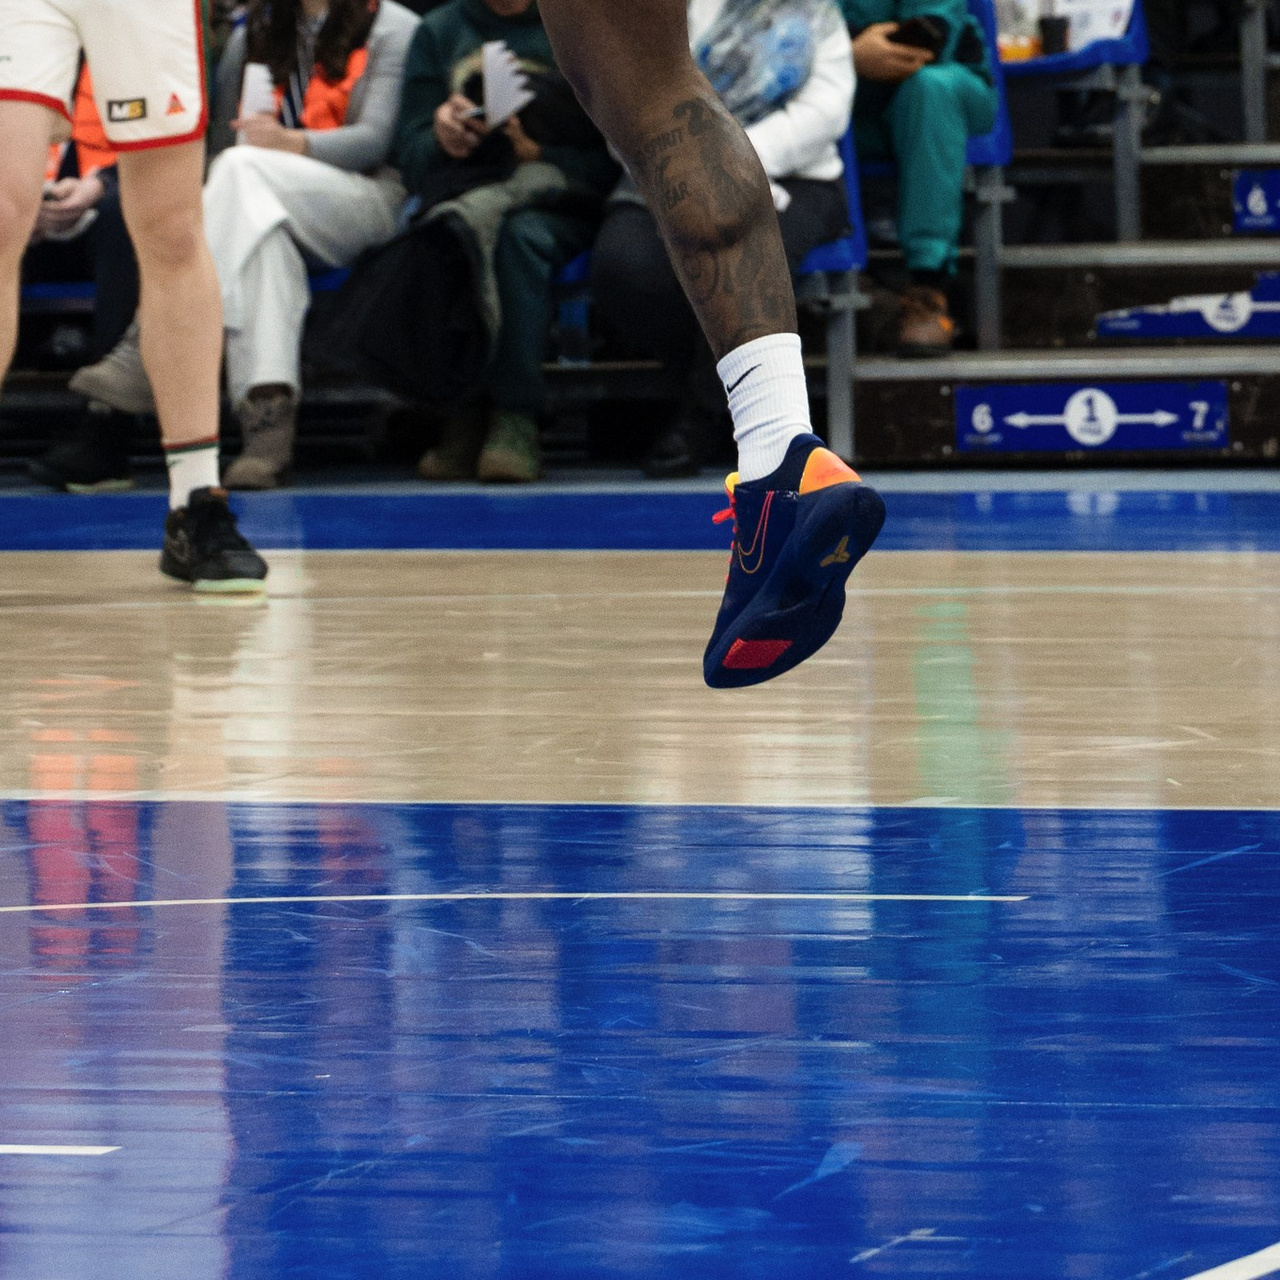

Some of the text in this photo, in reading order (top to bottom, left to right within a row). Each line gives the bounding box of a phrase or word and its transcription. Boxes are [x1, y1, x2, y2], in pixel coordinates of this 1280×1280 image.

[971, 395, 1210, 433] 6 1 7
